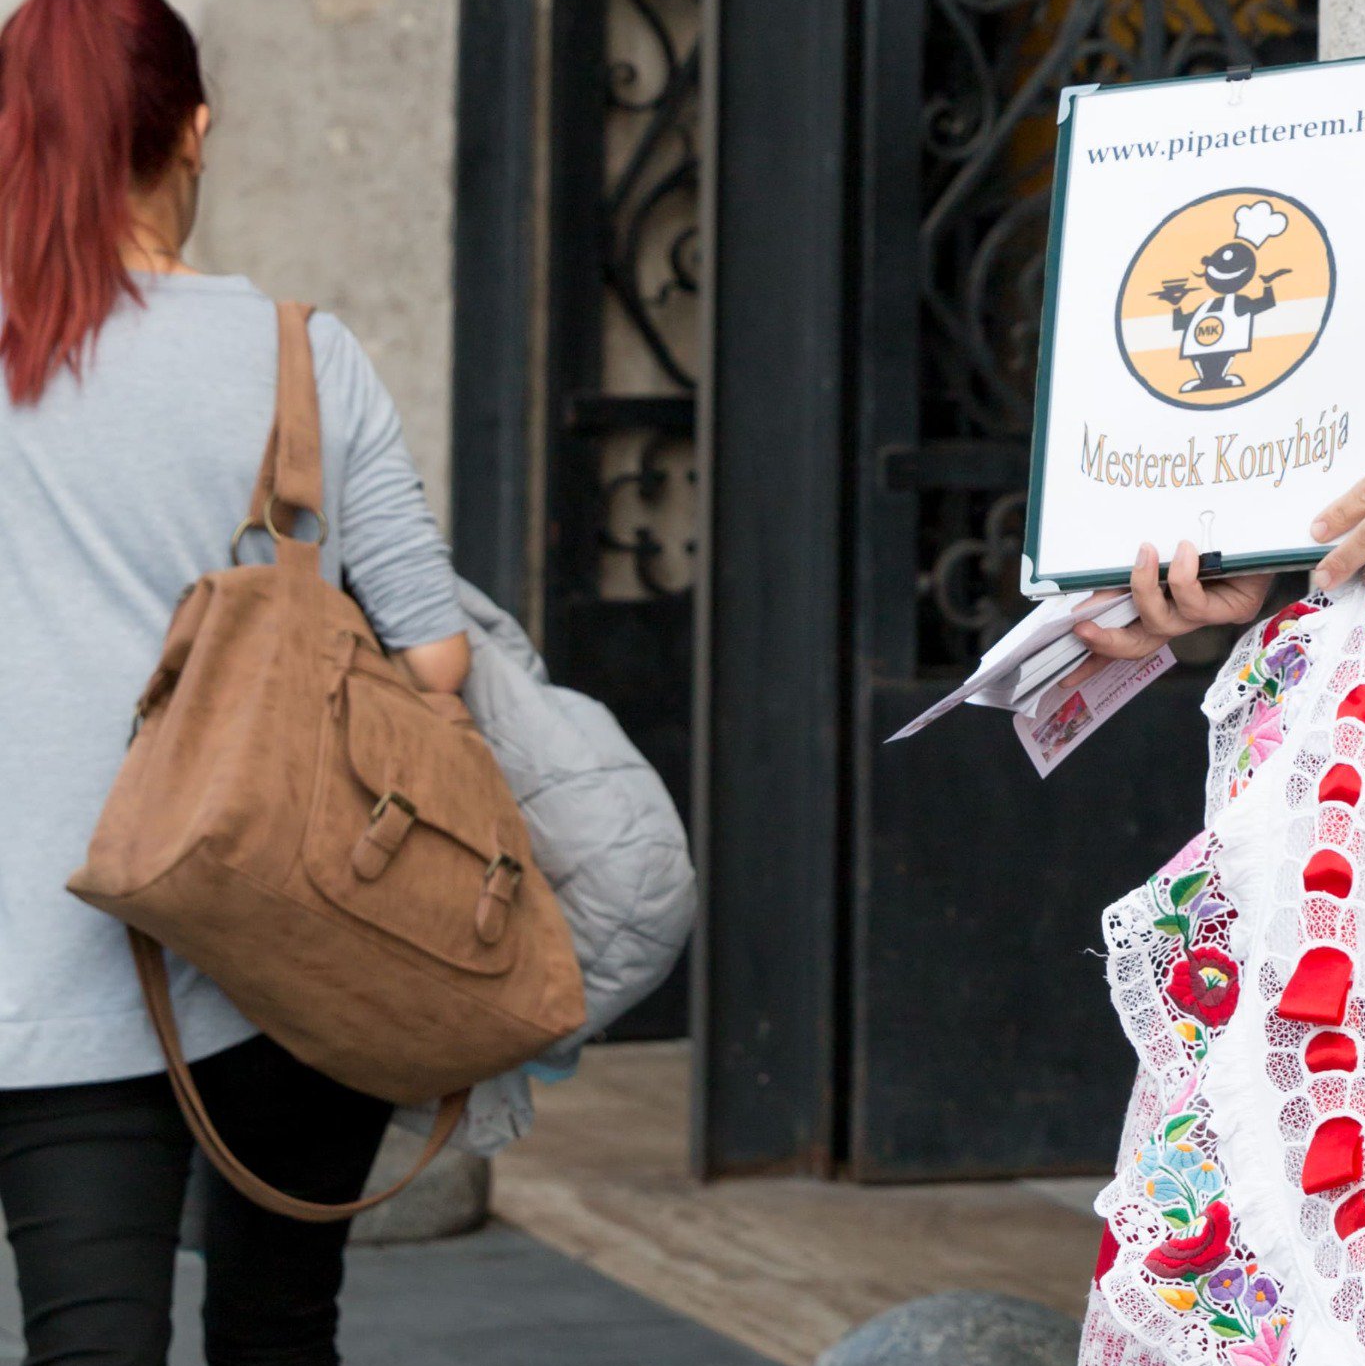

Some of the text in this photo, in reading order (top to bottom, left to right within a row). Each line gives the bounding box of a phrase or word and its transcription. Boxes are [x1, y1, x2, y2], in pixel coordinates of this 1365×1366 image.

[1198, 324, 1220, 337] MK
[1080, 404, 1350, 488] Mesterek Konyhája
